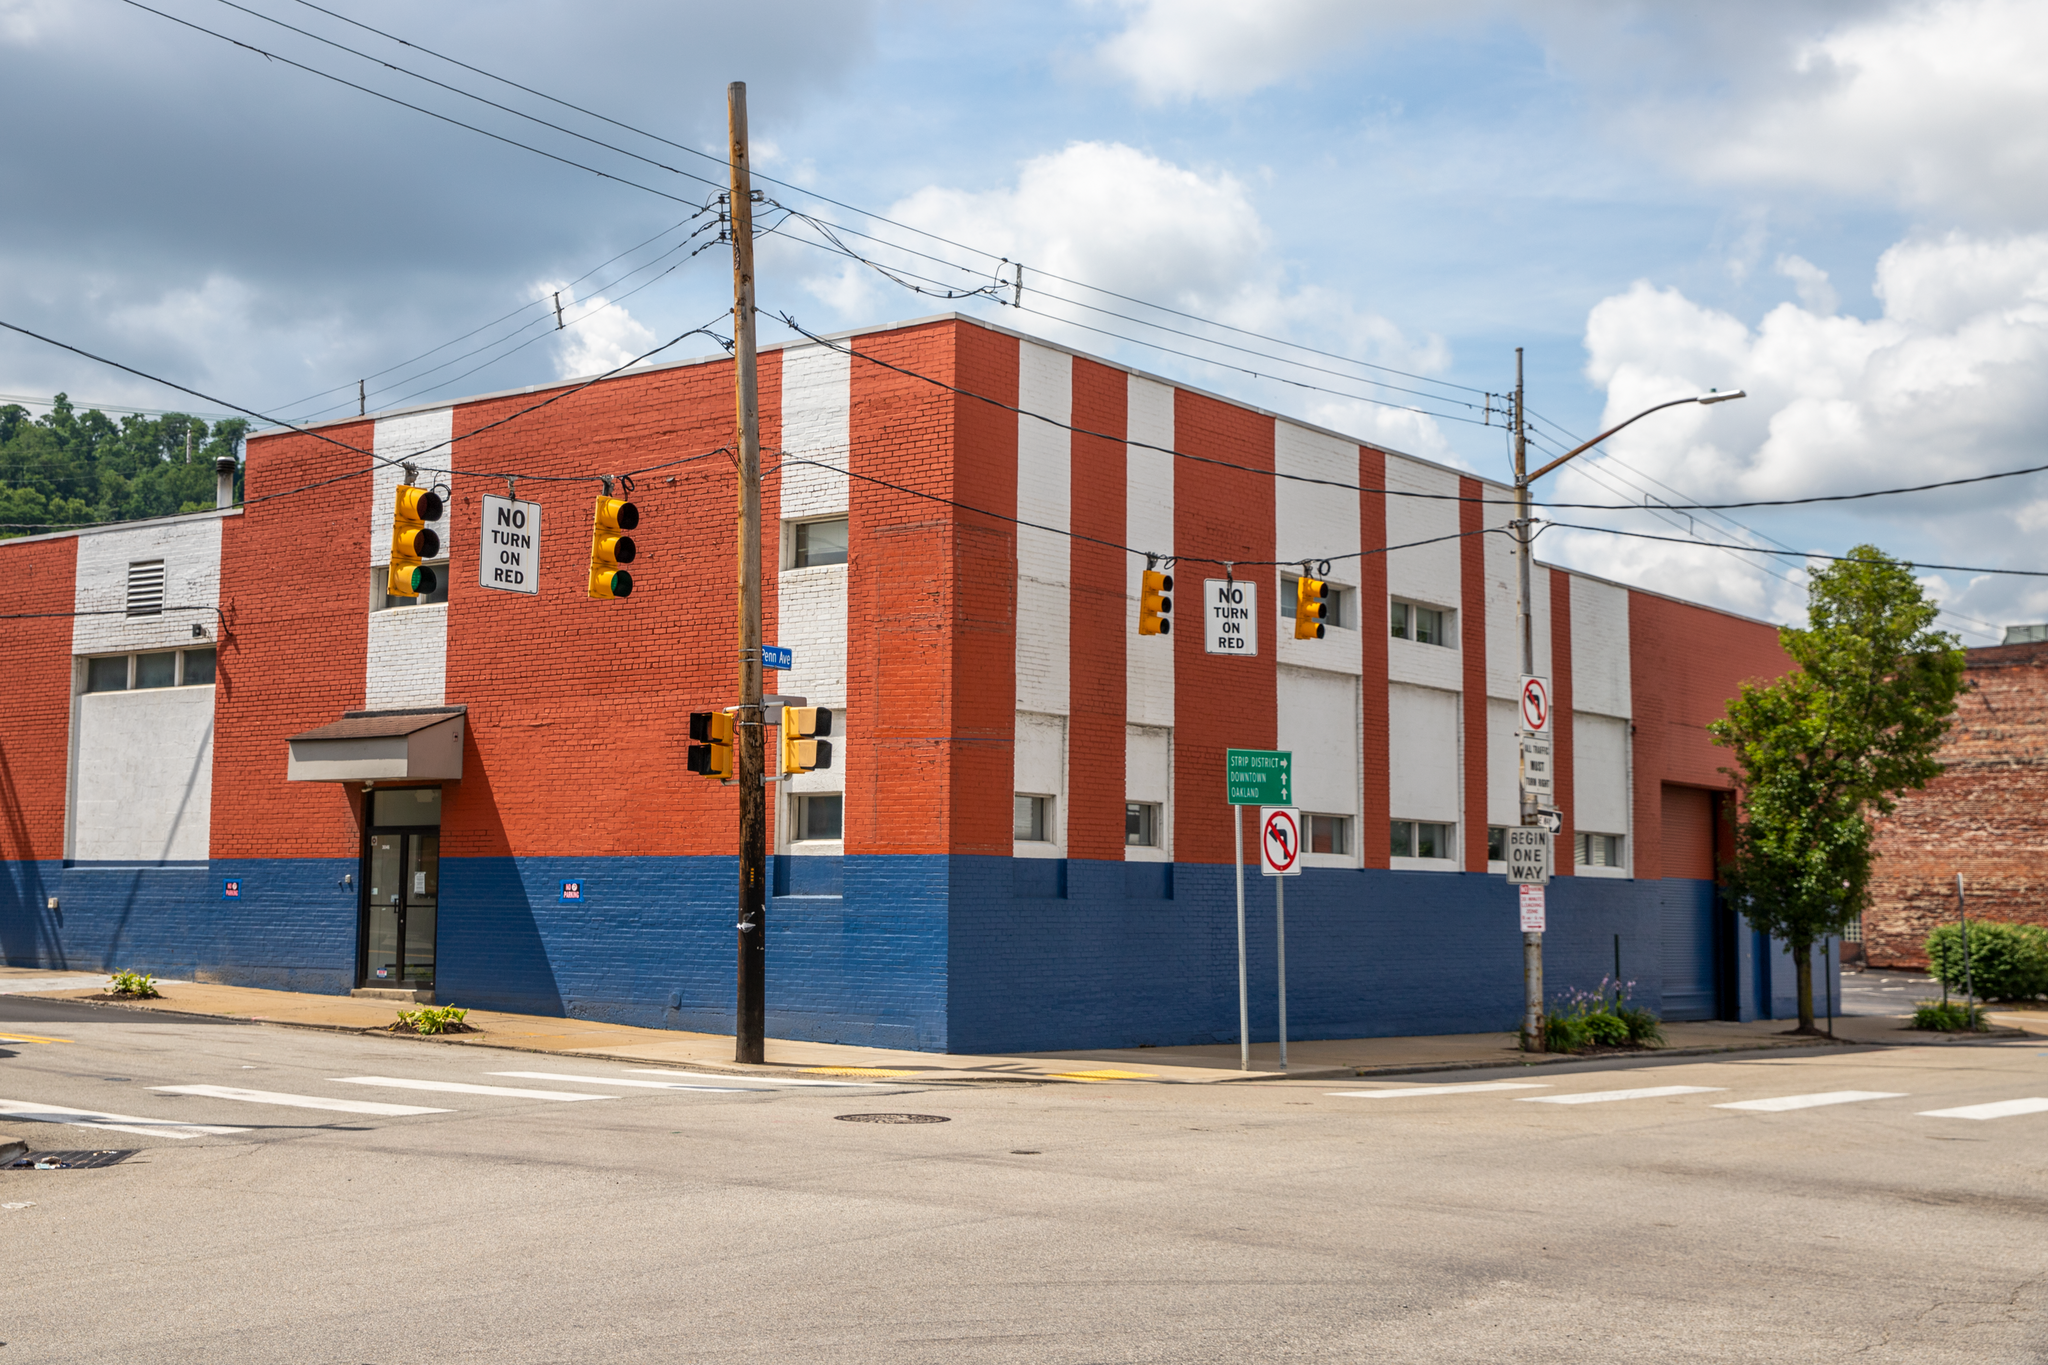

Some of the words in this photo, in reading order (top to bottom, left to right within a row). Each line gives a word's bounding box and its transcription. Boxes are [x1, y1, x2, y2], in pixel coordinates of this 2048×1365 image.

[497, 507, 526, 529] NO
[491, 529, 531, 549] TURN
[500, 550, 520, 566] ON
[494, 567, 524, 584] RED
[1219, 587, 1243, 604] NO
[1213, 606, 1248, 619] TURN
[1222, 622, 1240, 634] ON
[1218, 637, 1245, 649] RED
[779, 651, 791, 665] Ave
[1524, 744, 1532, 753] ALL
[1533, 745, 1550, 756] TRAFFIC
[1230, 756, 1249, 767] STRIP
[1251, 757, 1279, 768] DISTRICT
[1530, 760, 1545, 772] MUST
[1230, 771, 1267, 783] DOWNTOWN
[1525, 777, 1537, 786] TURN
[1538, 778, 1550, 788] RIGHT
[1231, 787, 1260, 798] OAKLAND
[1511, 832, 1546, 845] BEGIN
[1513, 848, 1542, 862] ONE
[1511, 865, 1544, 879] WAY
